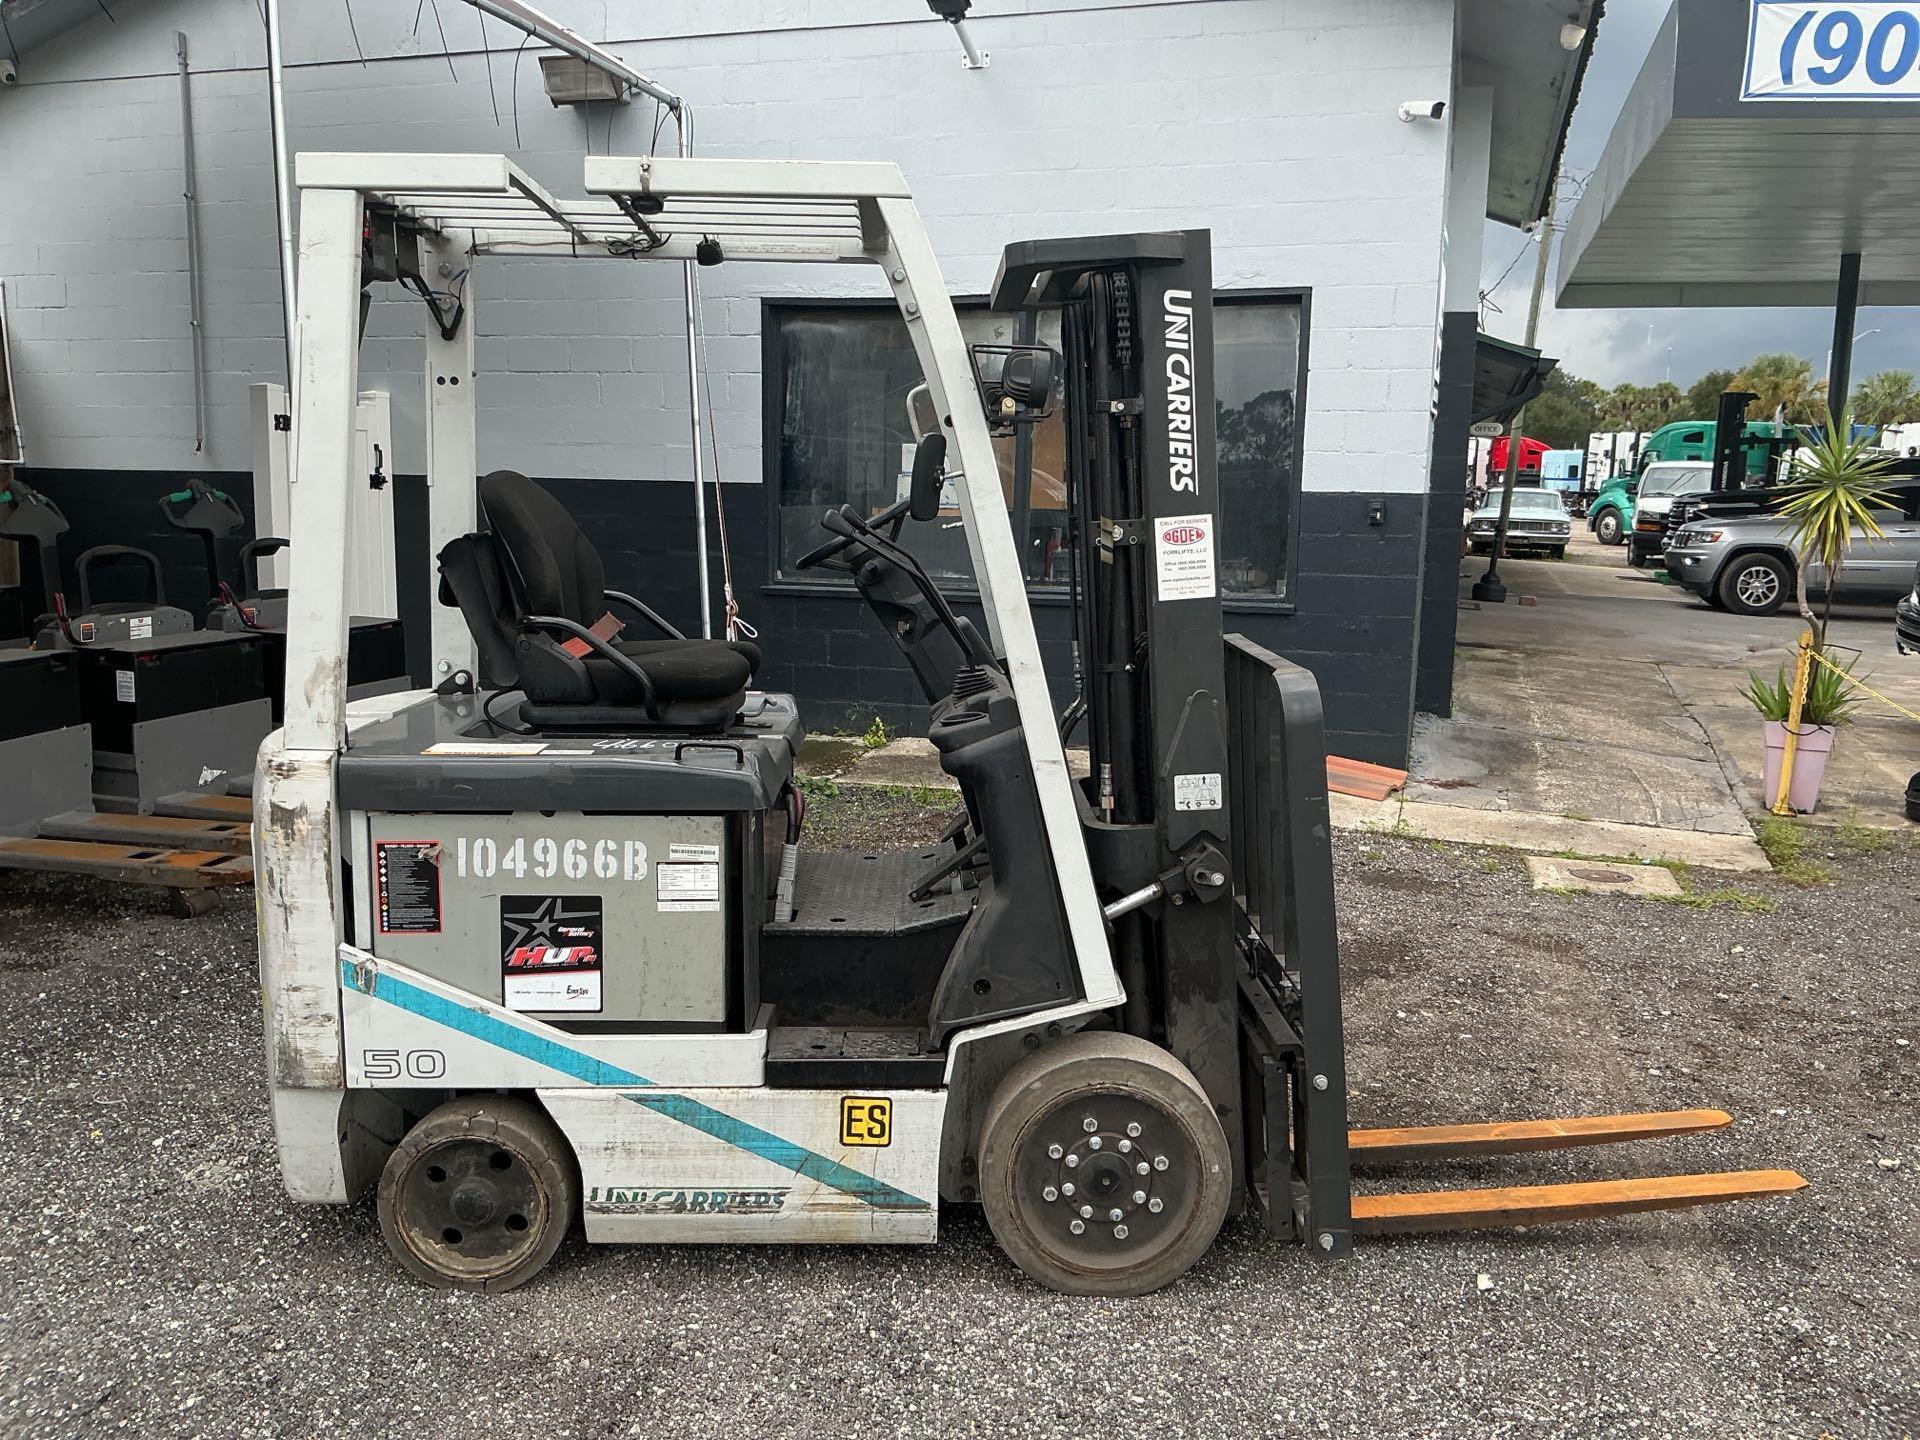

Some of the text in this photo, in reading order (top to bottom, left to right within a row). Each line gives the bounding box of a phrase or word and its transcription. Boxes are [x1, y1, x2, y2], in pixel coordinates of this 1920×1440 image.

[1779, 10, 1920, 86] (90
[1474, 425, 1498, 433] OFFICE
[1164, 528, 1203, 544] OGDEN
[566, 984, 589, 995] EnerSys
[363, 1049, 446, 1079] 50
[846, 1104, 887, 1139] ES
